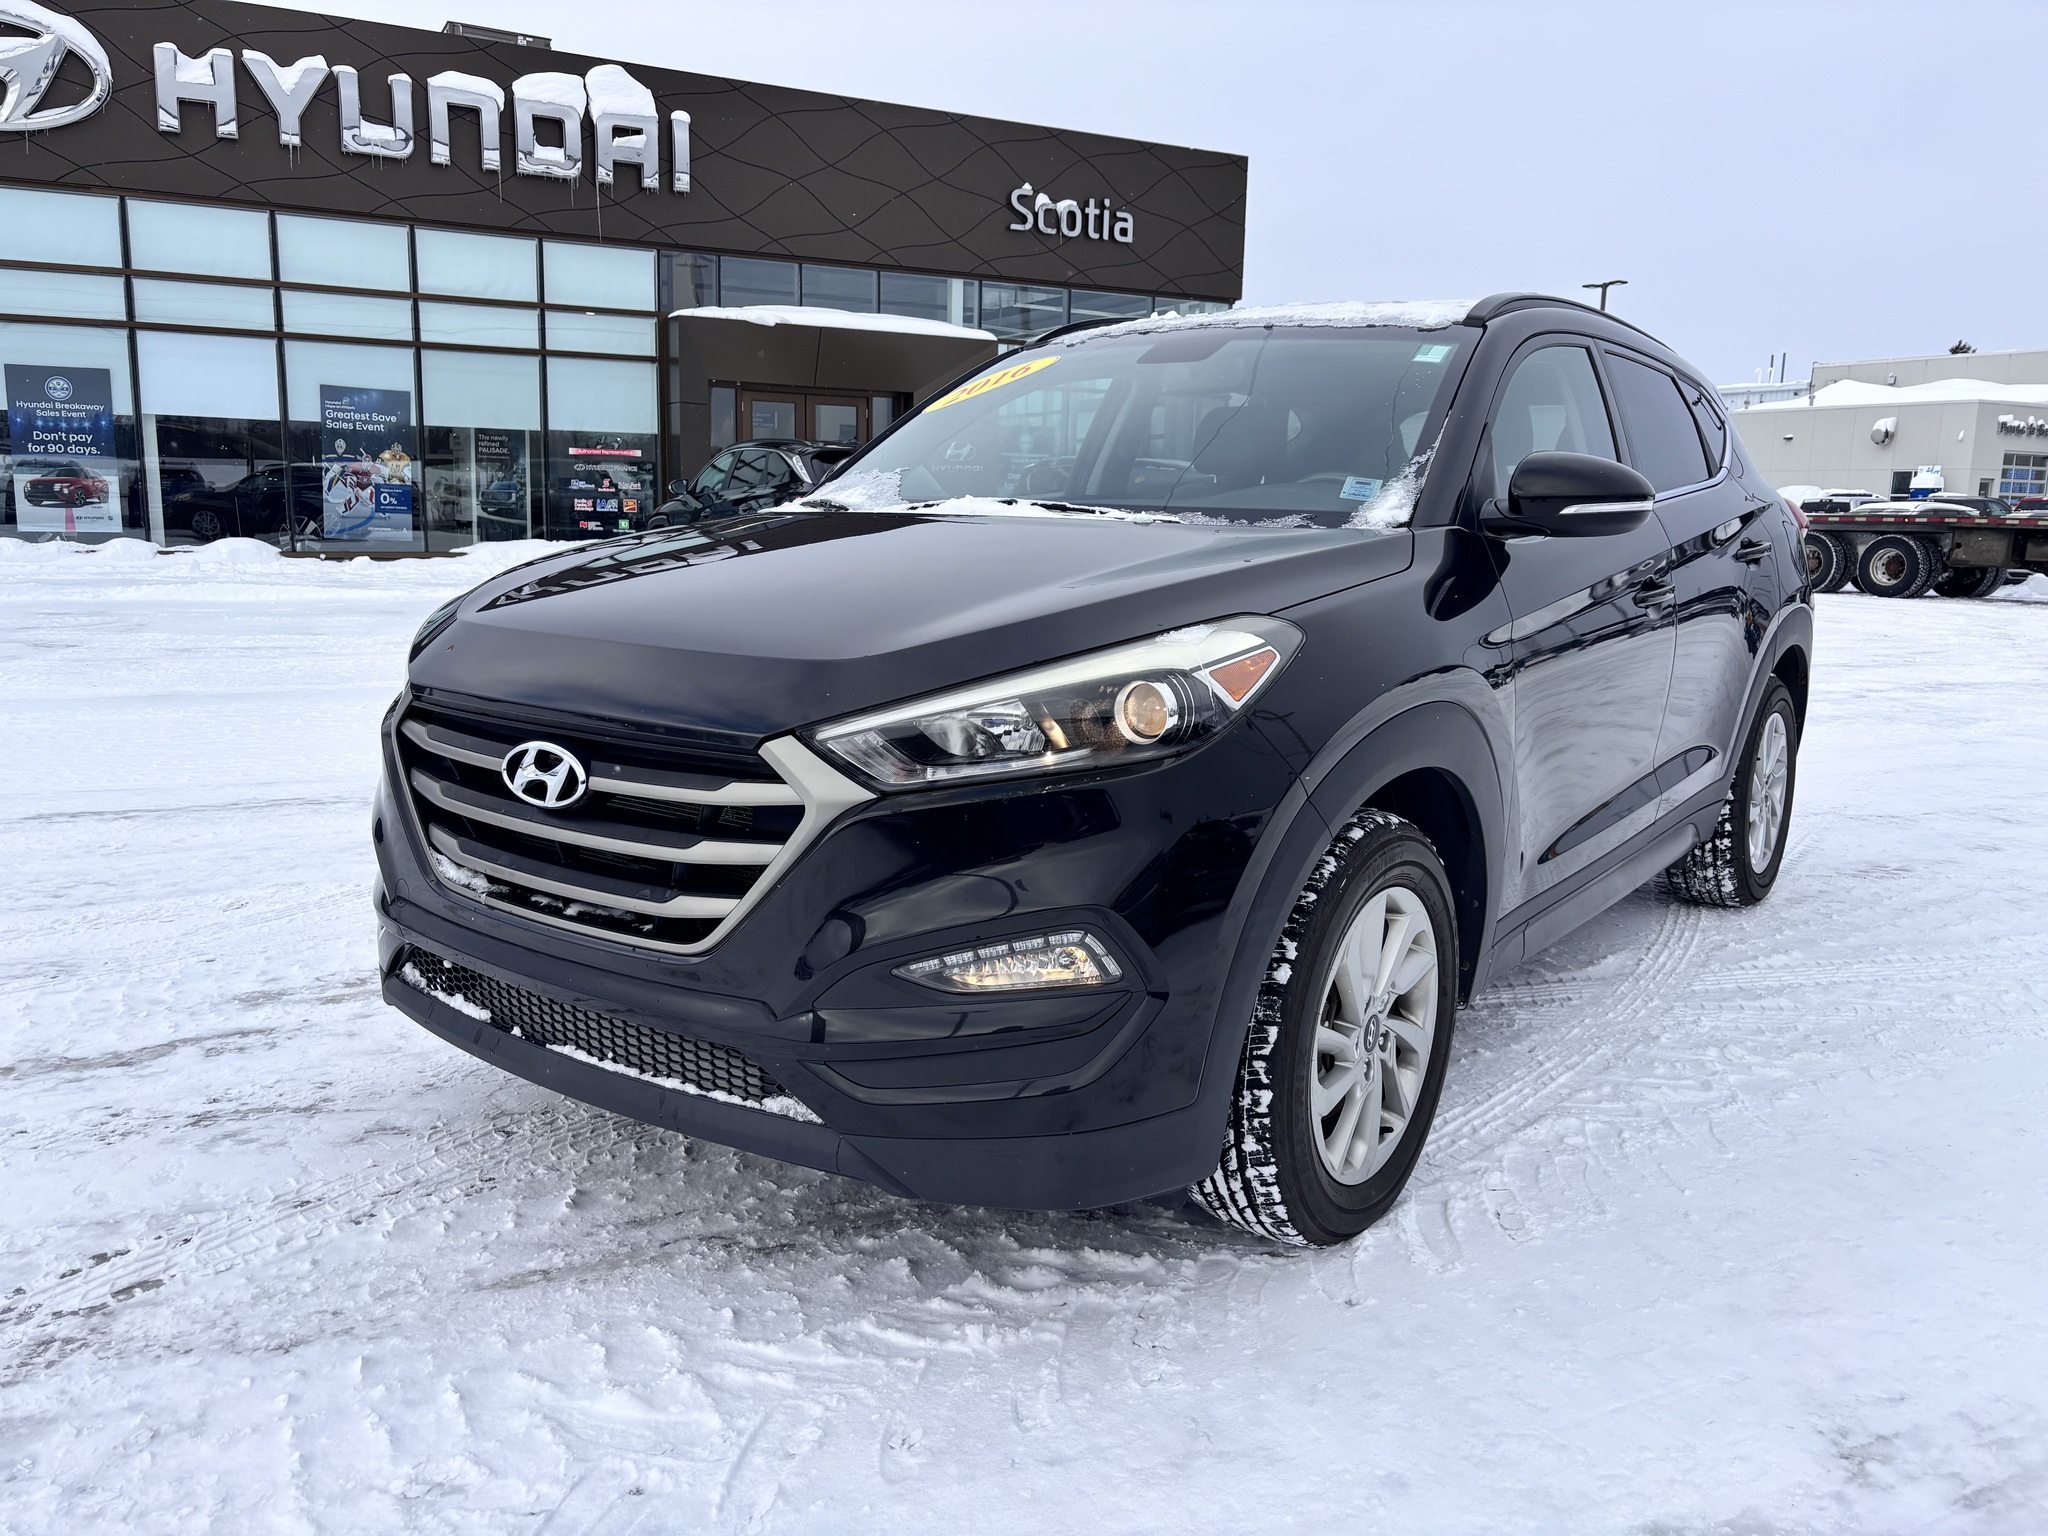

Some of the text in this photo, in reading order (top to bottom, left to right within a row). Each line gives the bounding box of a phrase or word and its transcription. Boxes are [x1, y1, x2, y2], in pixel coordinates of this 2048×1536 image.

[153, 42, 690, 193] HYUNDAI
[1009, 187, 1135, 244] Scotia
[942, 360, 1039, 407] 2016
[16, 400, 105, 412] Hyundai Breakaway
[36, 409, 87, 418] Sales Event
[325, 409, 397, 423] Greatest Save
[325, 419, 385, 432] Sales Event
[33, 430, 93, 444] Don't pay
[27, 442, 101, 456] for 90 days.
[380, 492, 398, 505] 0%
